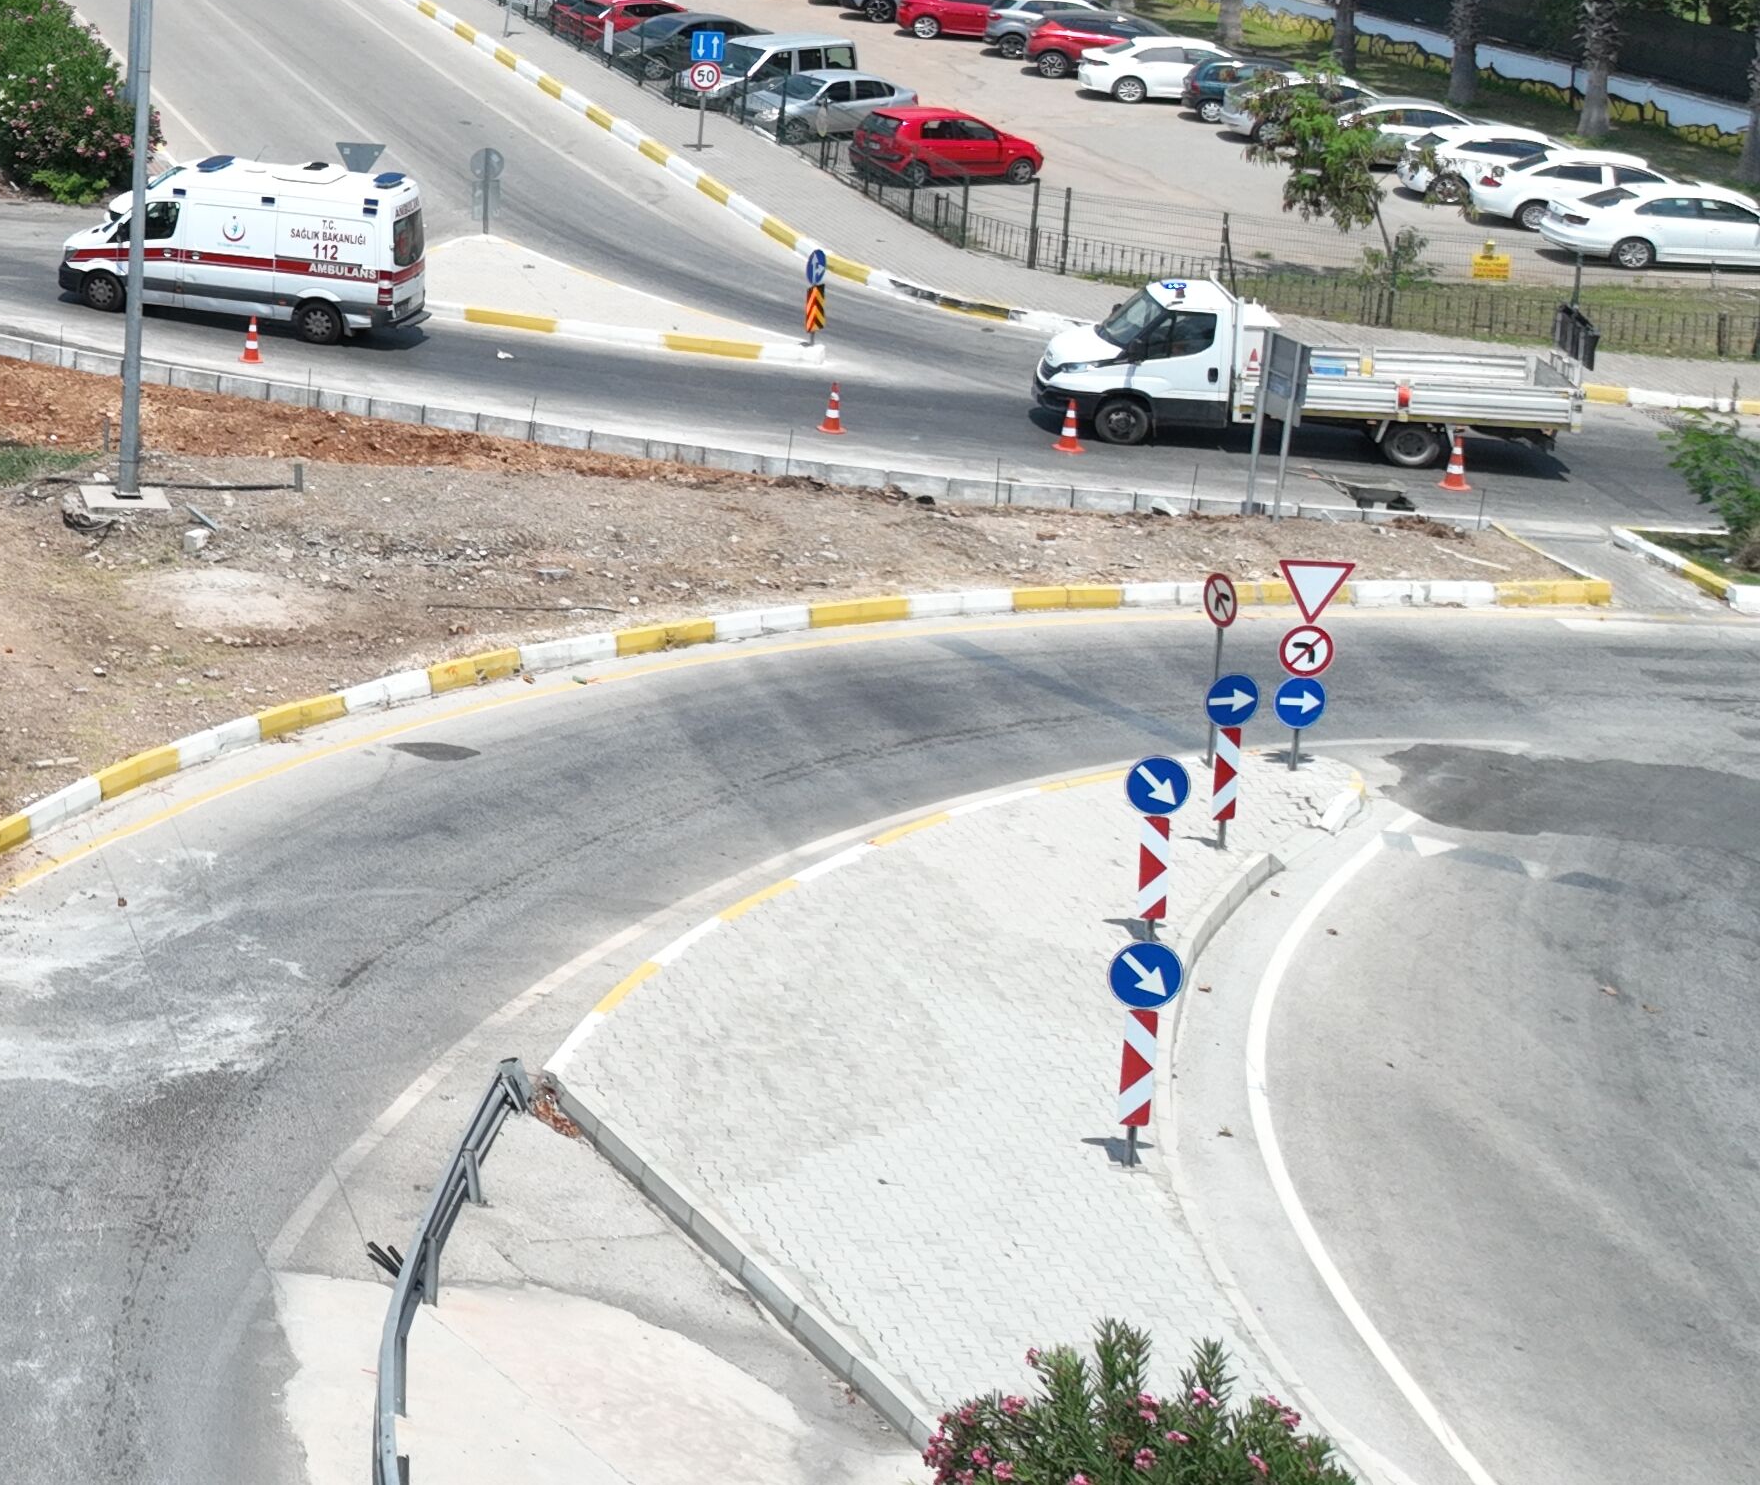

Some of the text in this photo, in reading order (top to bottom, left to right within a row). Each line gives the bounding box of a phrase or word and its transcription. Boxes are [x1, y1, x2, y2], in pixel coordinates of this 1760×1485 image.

[697, 70, 715, 83] 50
[322, 220, 337, 230] T.C.
[290, 227, 367, 245] SAĞLIK BAKANLIĞI
[313, 243, 339, 261] 112
[308, 263, 378, 279] AMBULANS
